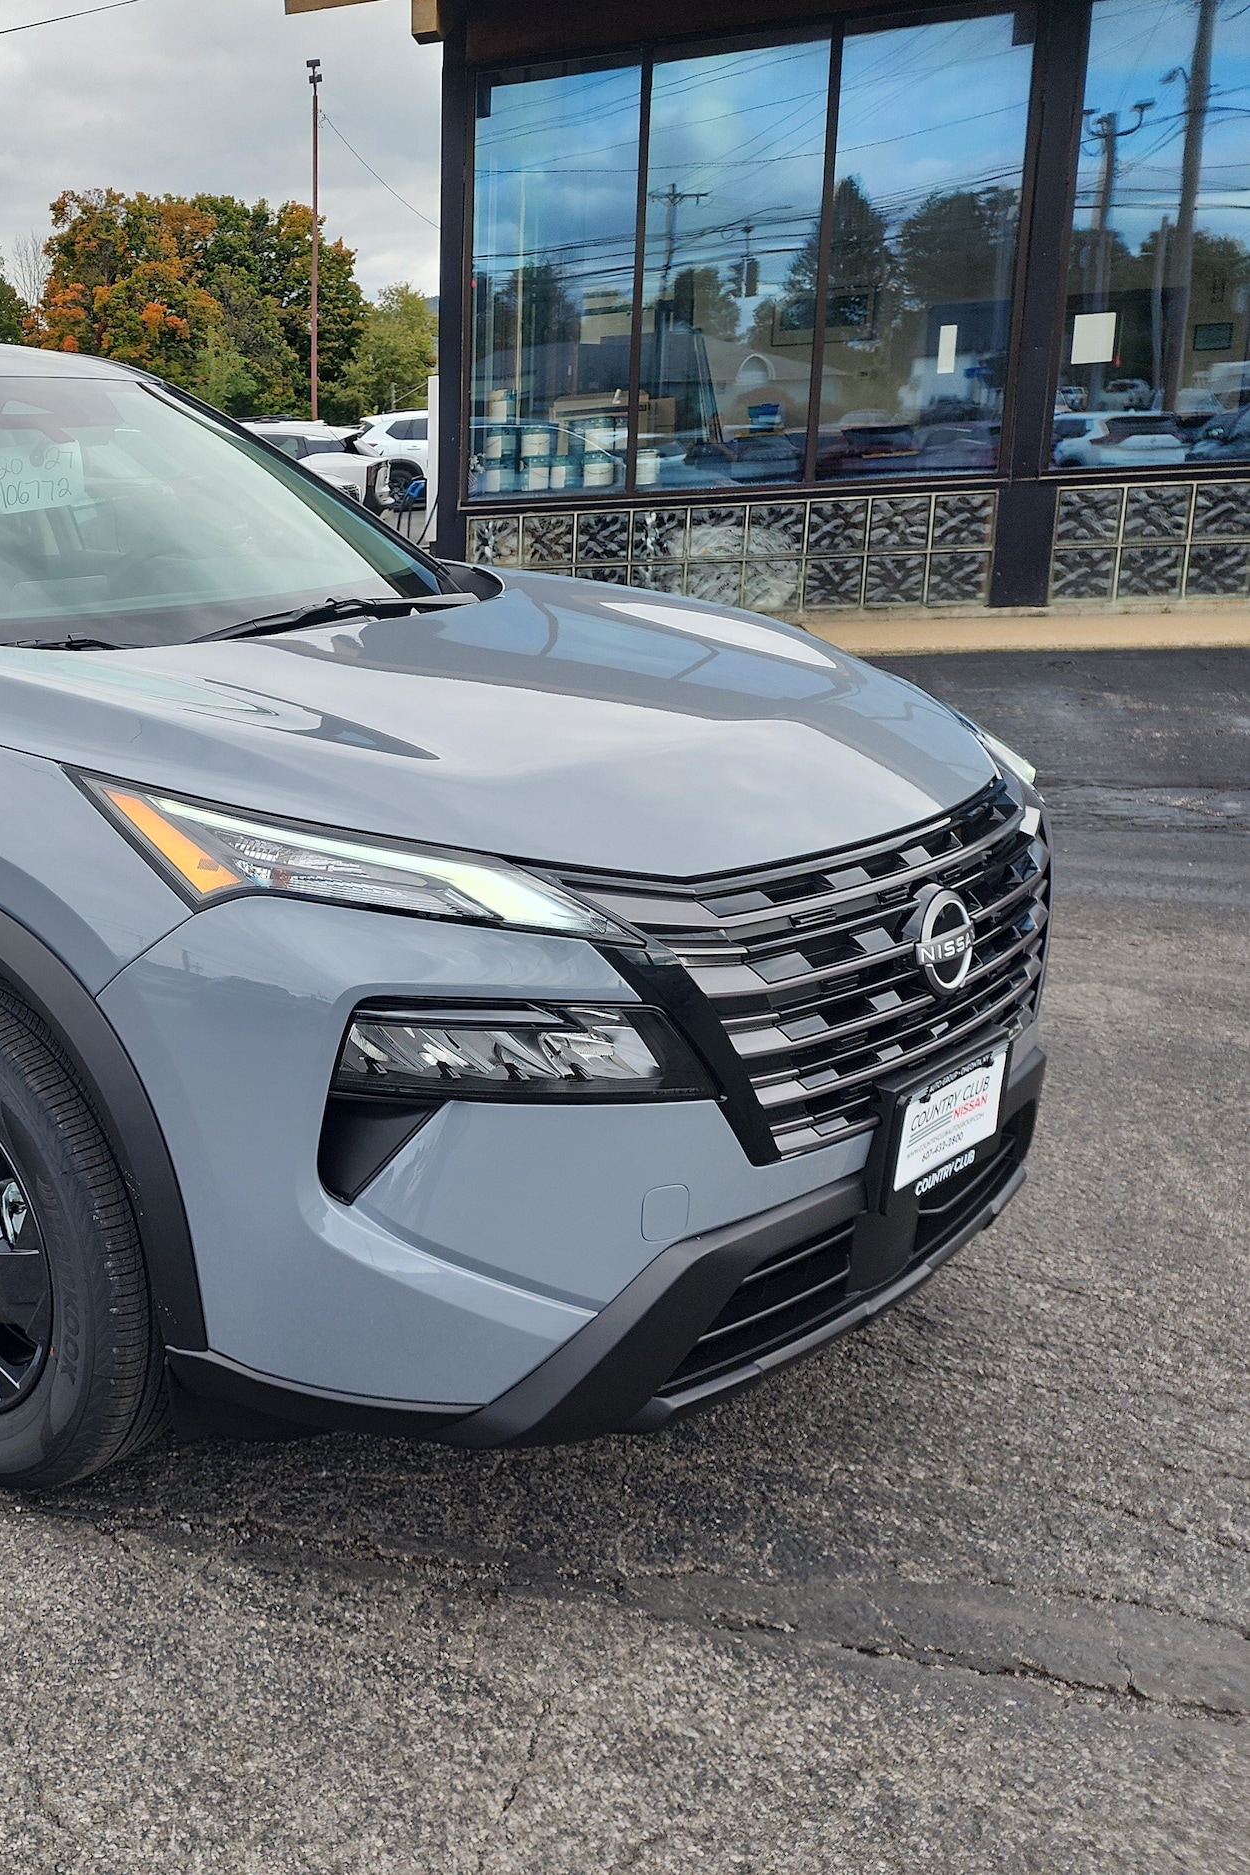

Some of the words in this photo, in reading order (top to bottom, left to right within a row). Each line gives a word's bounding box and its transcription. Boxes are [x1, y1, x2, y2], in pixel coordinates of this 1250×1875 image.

[0, 477, 72, 509] 106772
[911, 1089, 960, 1131] COUNTRY
[962, 1076, 990, 1102] CLUB
[952, 1094, 988, 1120] NISSAN
[915, 1162, 955, 1196] COUNTRY
[953, 1149, 976, 1173] CLUB
